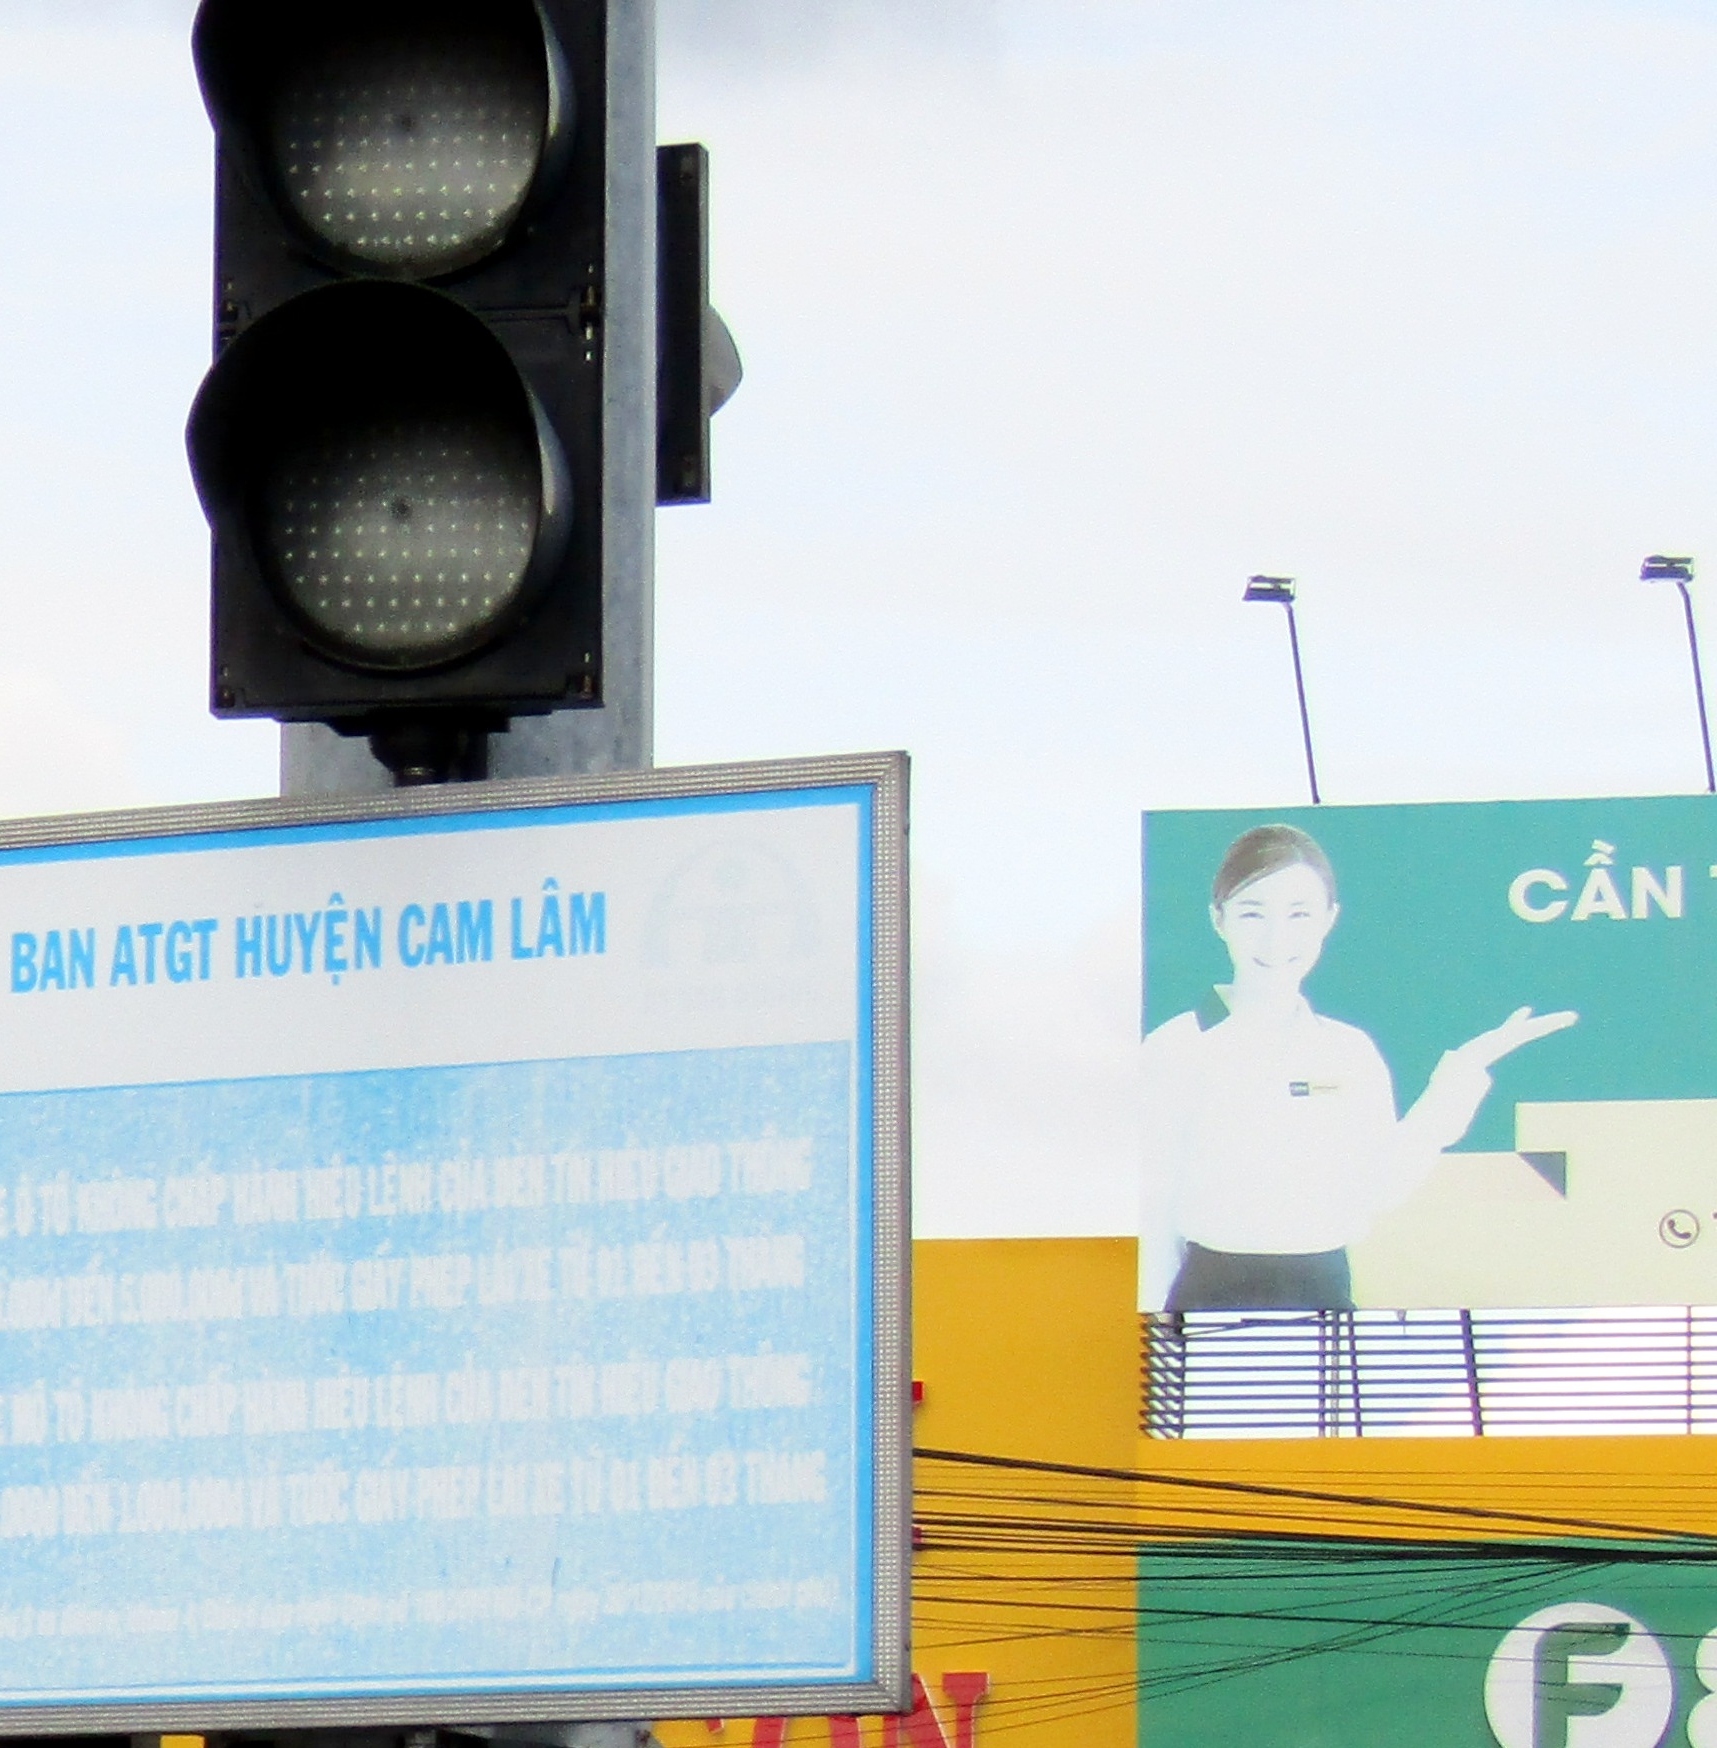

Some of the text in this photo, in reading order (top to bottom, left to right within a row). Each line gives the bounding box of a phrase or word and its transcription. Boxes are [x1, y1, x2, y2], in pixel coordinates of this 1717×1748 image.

[1508, 840, 1683, 923] CẦN
[10, 878, 606, 995] BAN ATGT HUYỆN CAM LÂM
